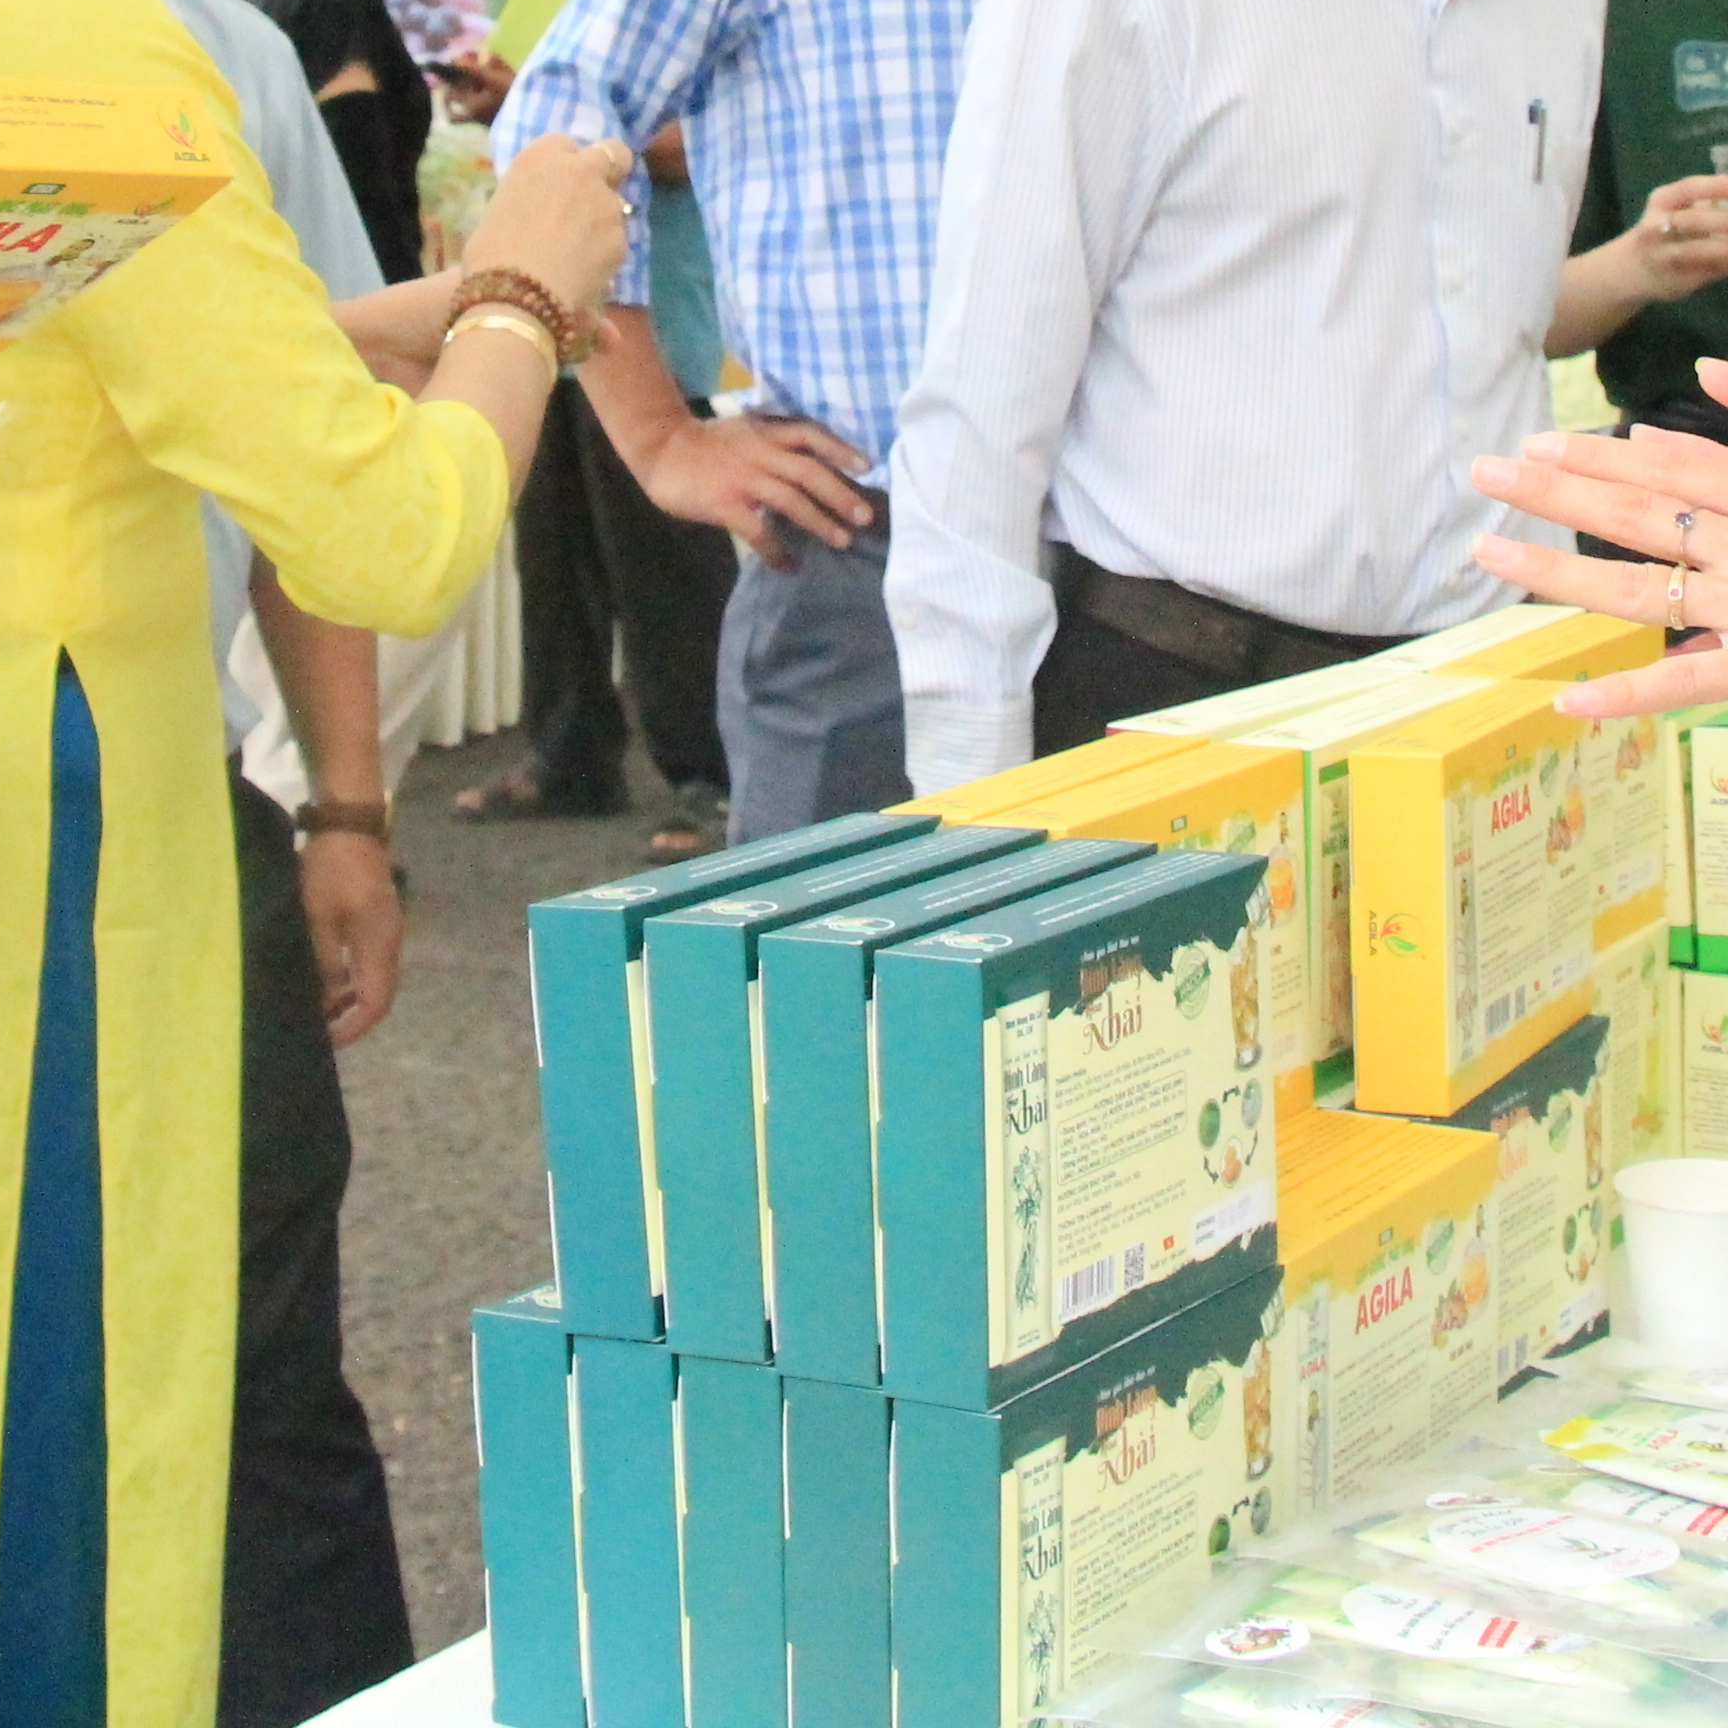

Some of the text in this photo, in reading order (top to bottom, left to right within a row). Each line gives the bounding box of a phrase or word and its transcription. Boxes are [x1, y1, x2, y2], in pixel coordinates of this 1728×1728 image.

[1491, 784, 1532, 837] AGILA
[1367, 910, 1379, 957] AGILA
[1355, 1265, 1414, 1336] AGILA
